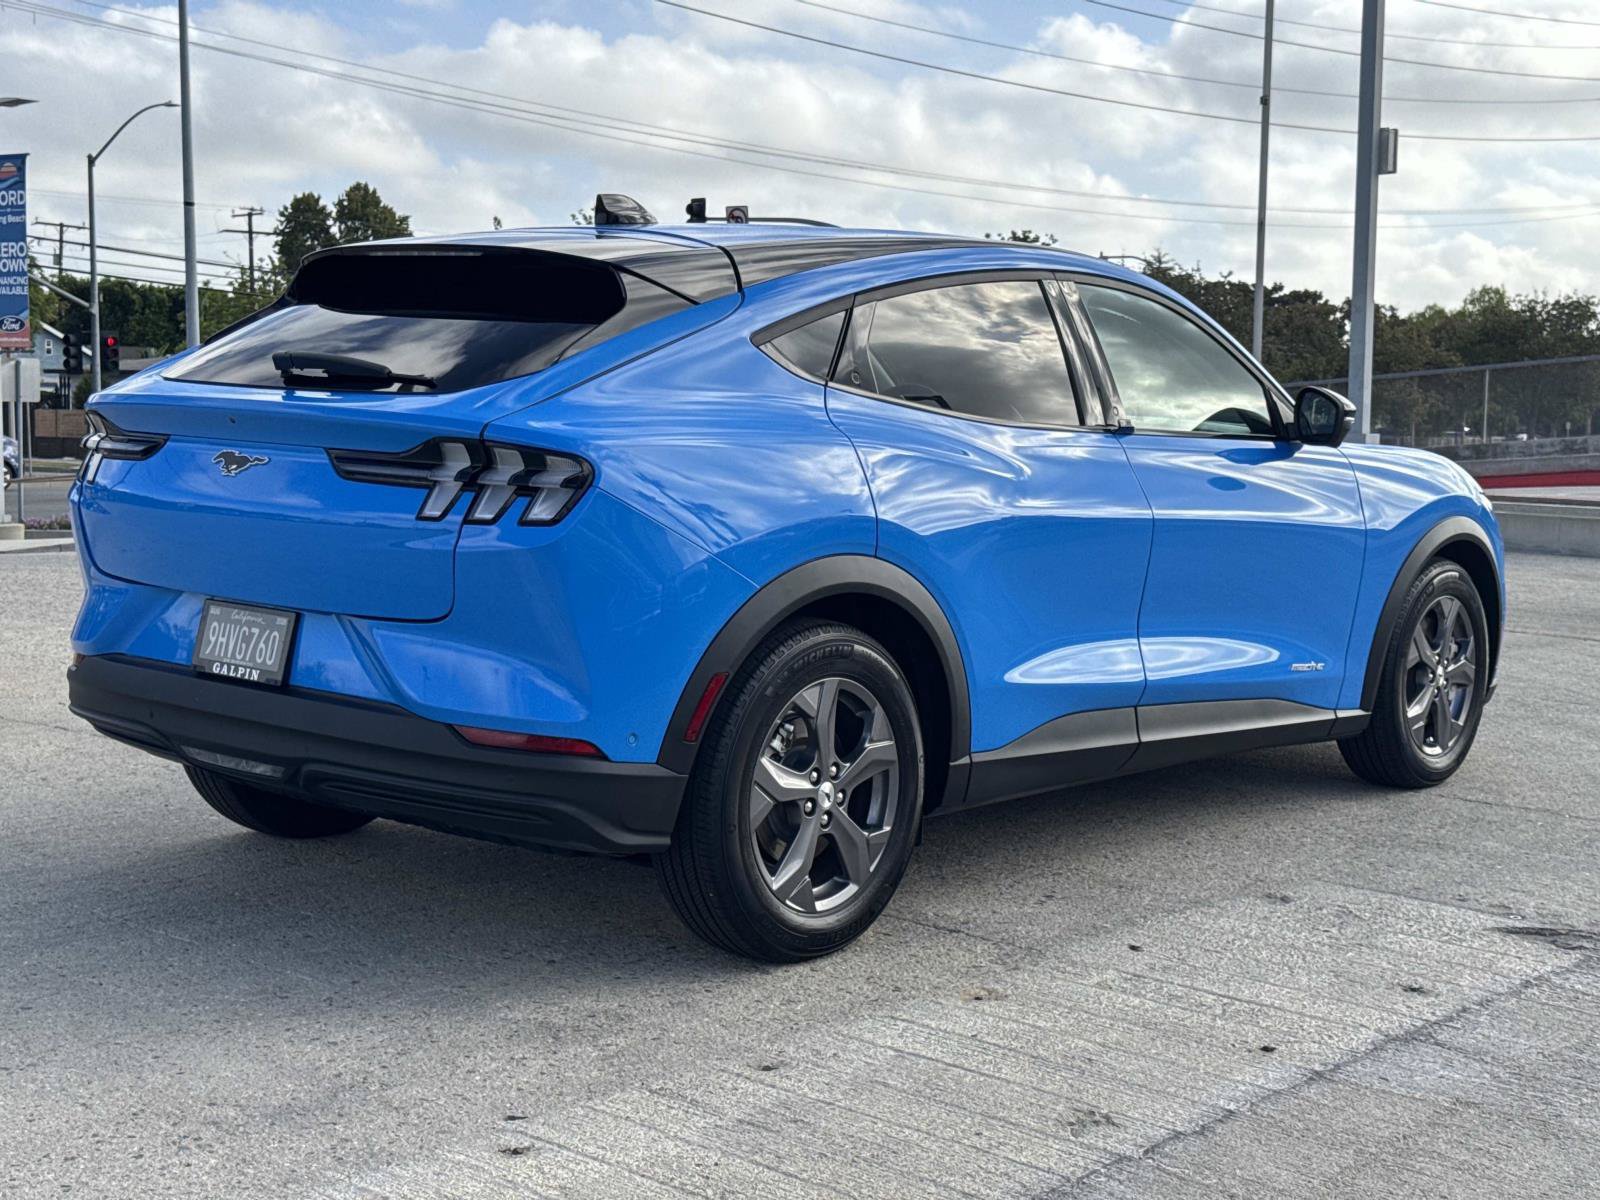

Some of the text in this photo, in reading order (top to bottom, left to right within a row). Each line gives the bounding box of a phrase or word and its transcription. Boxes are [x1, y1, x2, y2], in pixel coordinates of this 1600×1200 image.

[0, 241, 27, 257] ERO
[2, 317, 21, 330] Ford
[205, 621, 280, 666] 9HVG760
[212, 662, 260, 681] GALPIN
